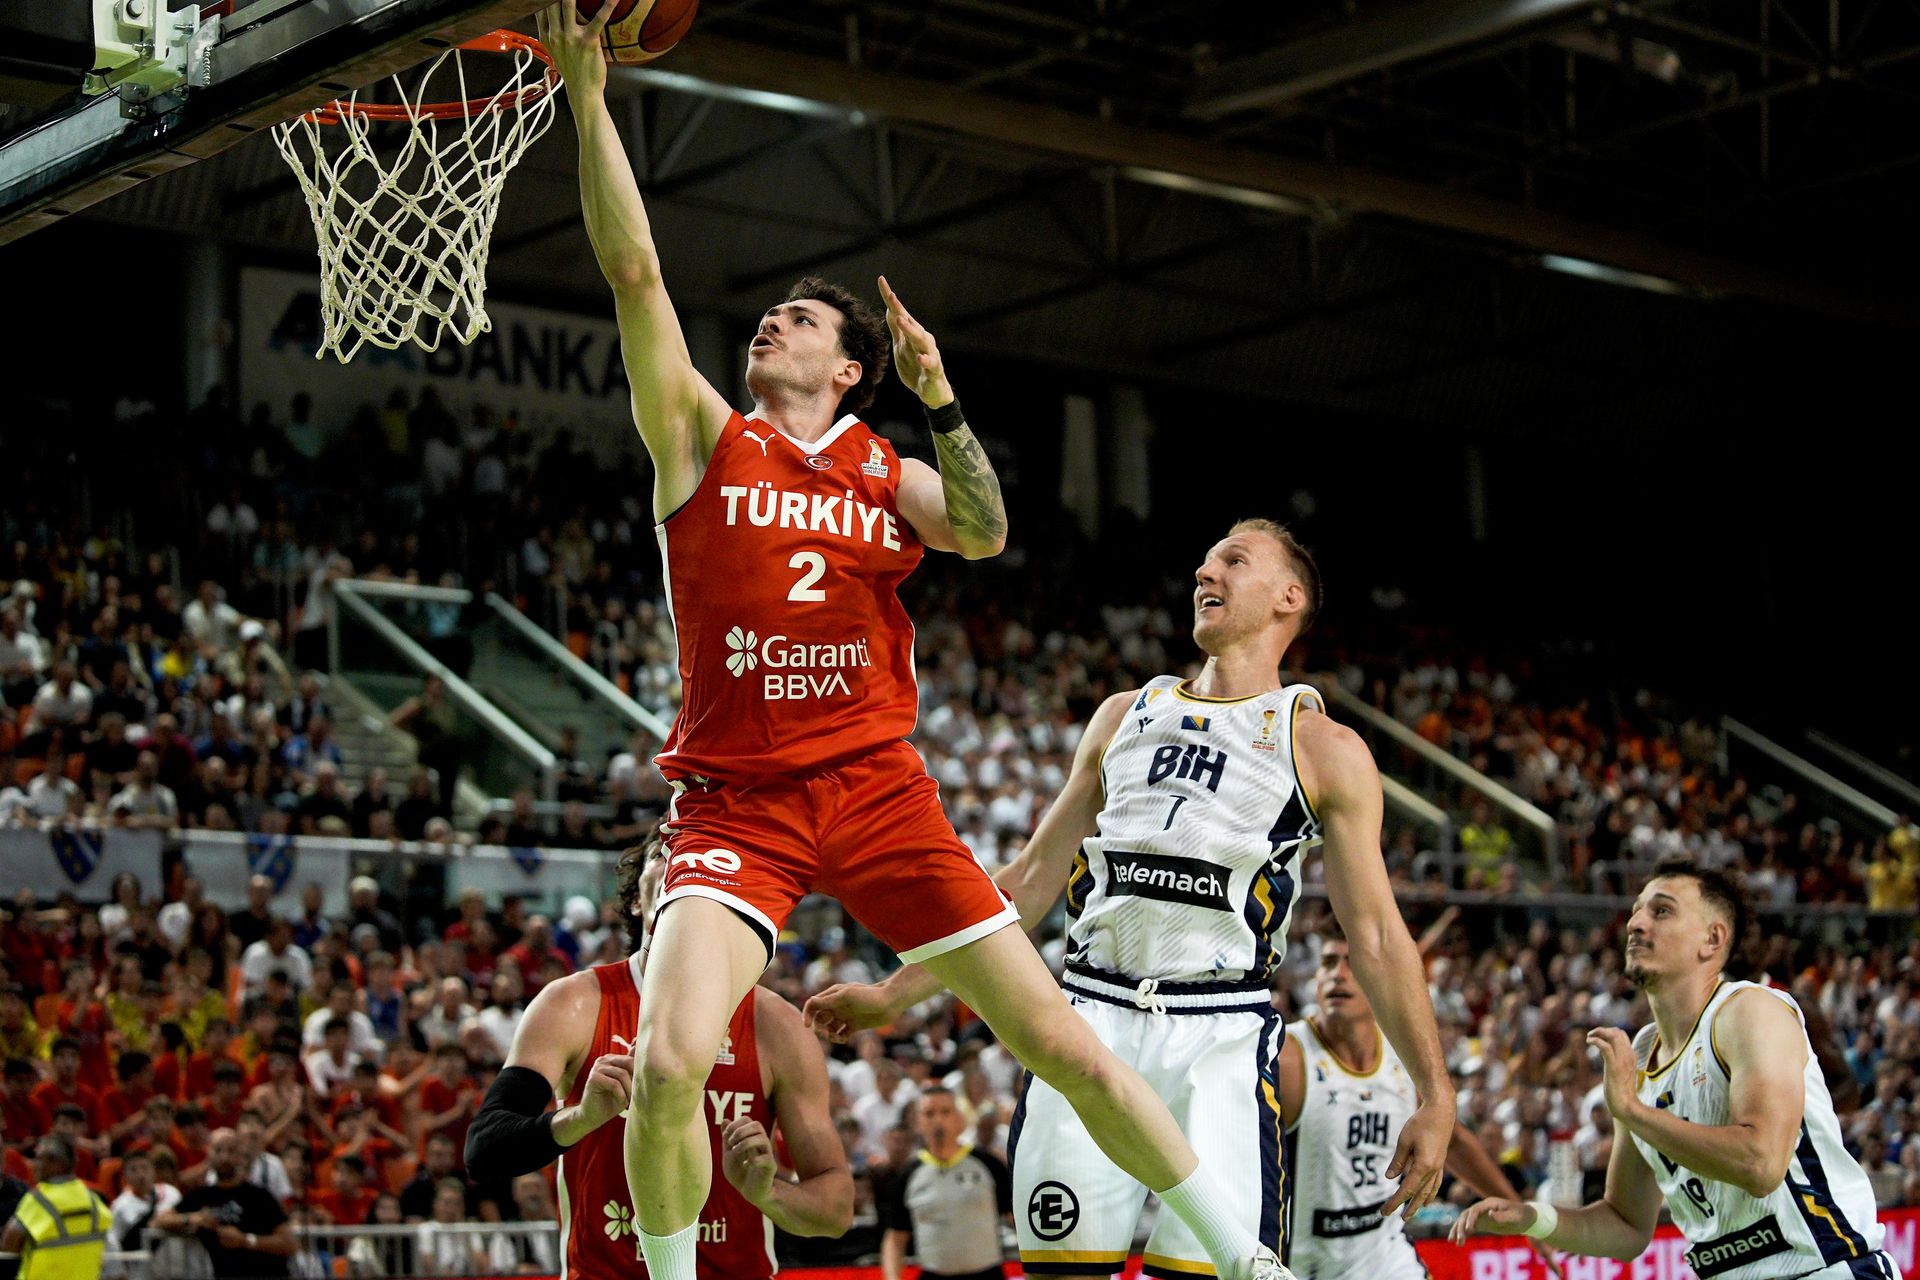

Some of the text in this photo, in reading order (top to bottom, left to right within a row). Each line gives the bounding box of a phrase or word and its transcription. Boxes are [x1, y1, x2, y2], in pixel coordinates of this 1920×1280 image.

[720, 481, 901, 552] TÜRKİYE
[787, 551, 826, 602] 2
[761, 635, 872, 669] Garanti
[764, 671, 852, 700] BBVA
[1163, 794, 1188, 832] 7
[1112, 861, 1224, 898] telemach
[1347, 1112, 1389, 1149] BIH
[1351, 1154, 1378, 1188] 55
